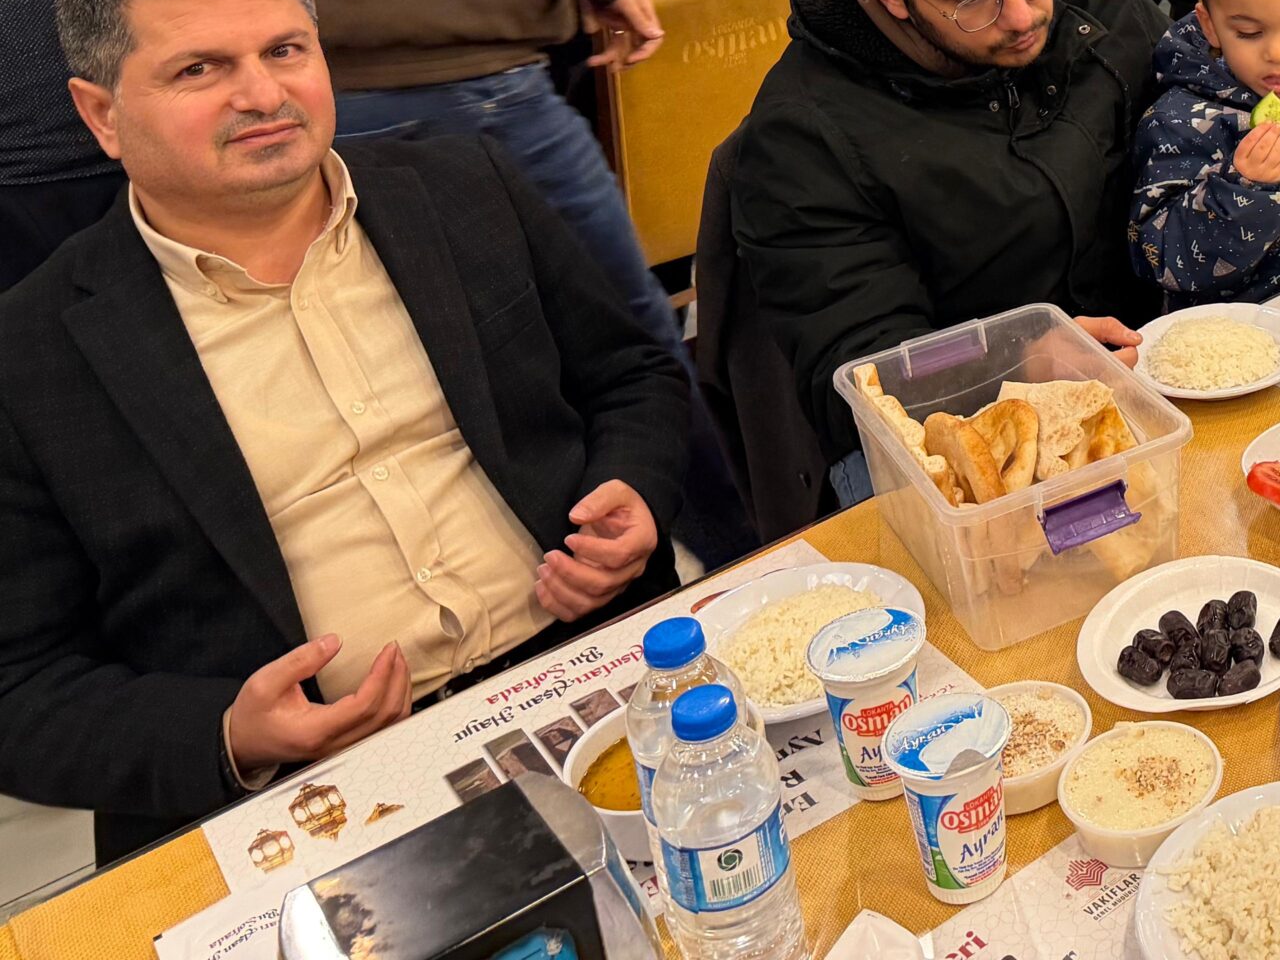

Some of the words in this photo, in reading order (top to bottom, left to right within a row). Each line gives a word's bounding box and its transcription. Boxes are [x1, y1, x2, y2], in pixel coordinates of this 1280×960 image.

[569, 645, 604, 669] Bu
[485, 662, 566, 705] Sofrada
[453, 705, 515, 743] Hayır
[861, 703, 895, 718] LOKANTA
[890, 723, 949, 756] Ayran
[964, 786, 995, 811] LOKANTA
[1083, 872, 1141, 917] VAKIFLAR
